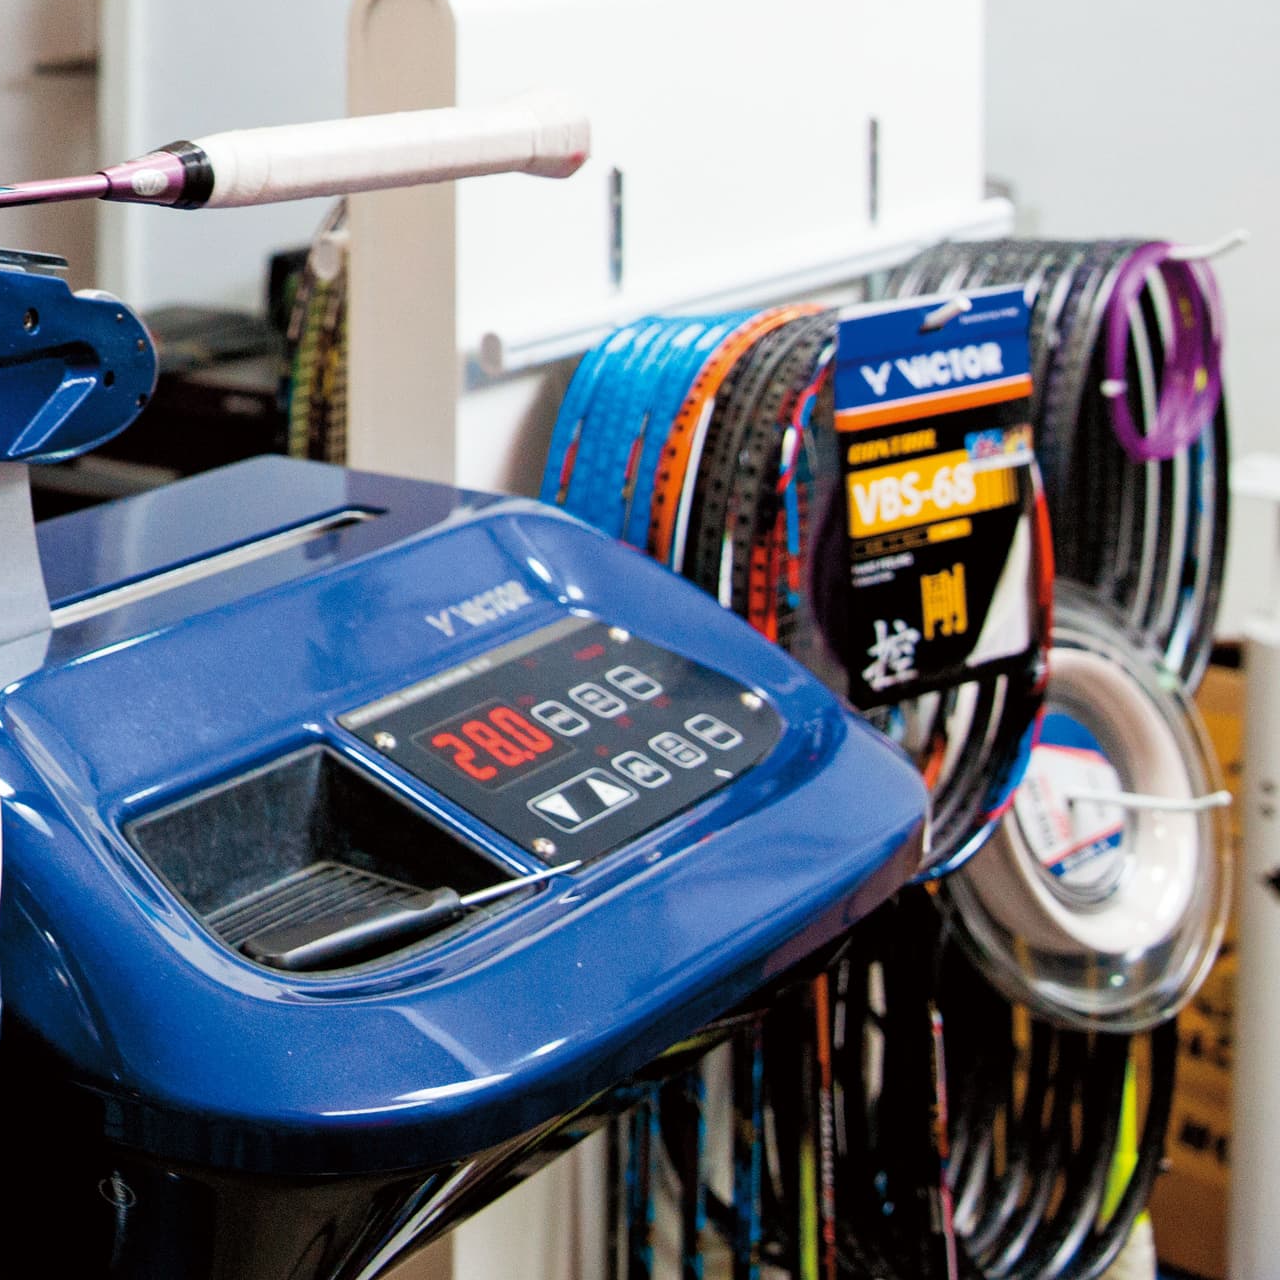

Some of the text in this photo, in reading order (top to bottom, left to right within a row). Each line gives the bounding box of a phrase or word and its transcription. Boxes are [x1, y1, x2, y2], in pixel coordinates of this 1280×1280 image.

[895, 342, 1004, 389] VICTOR
[852, 462, 976, 526] VBS-68
[447, 580, 534, 628] VICTOR
[431, 705, 555, 783] 28.0
